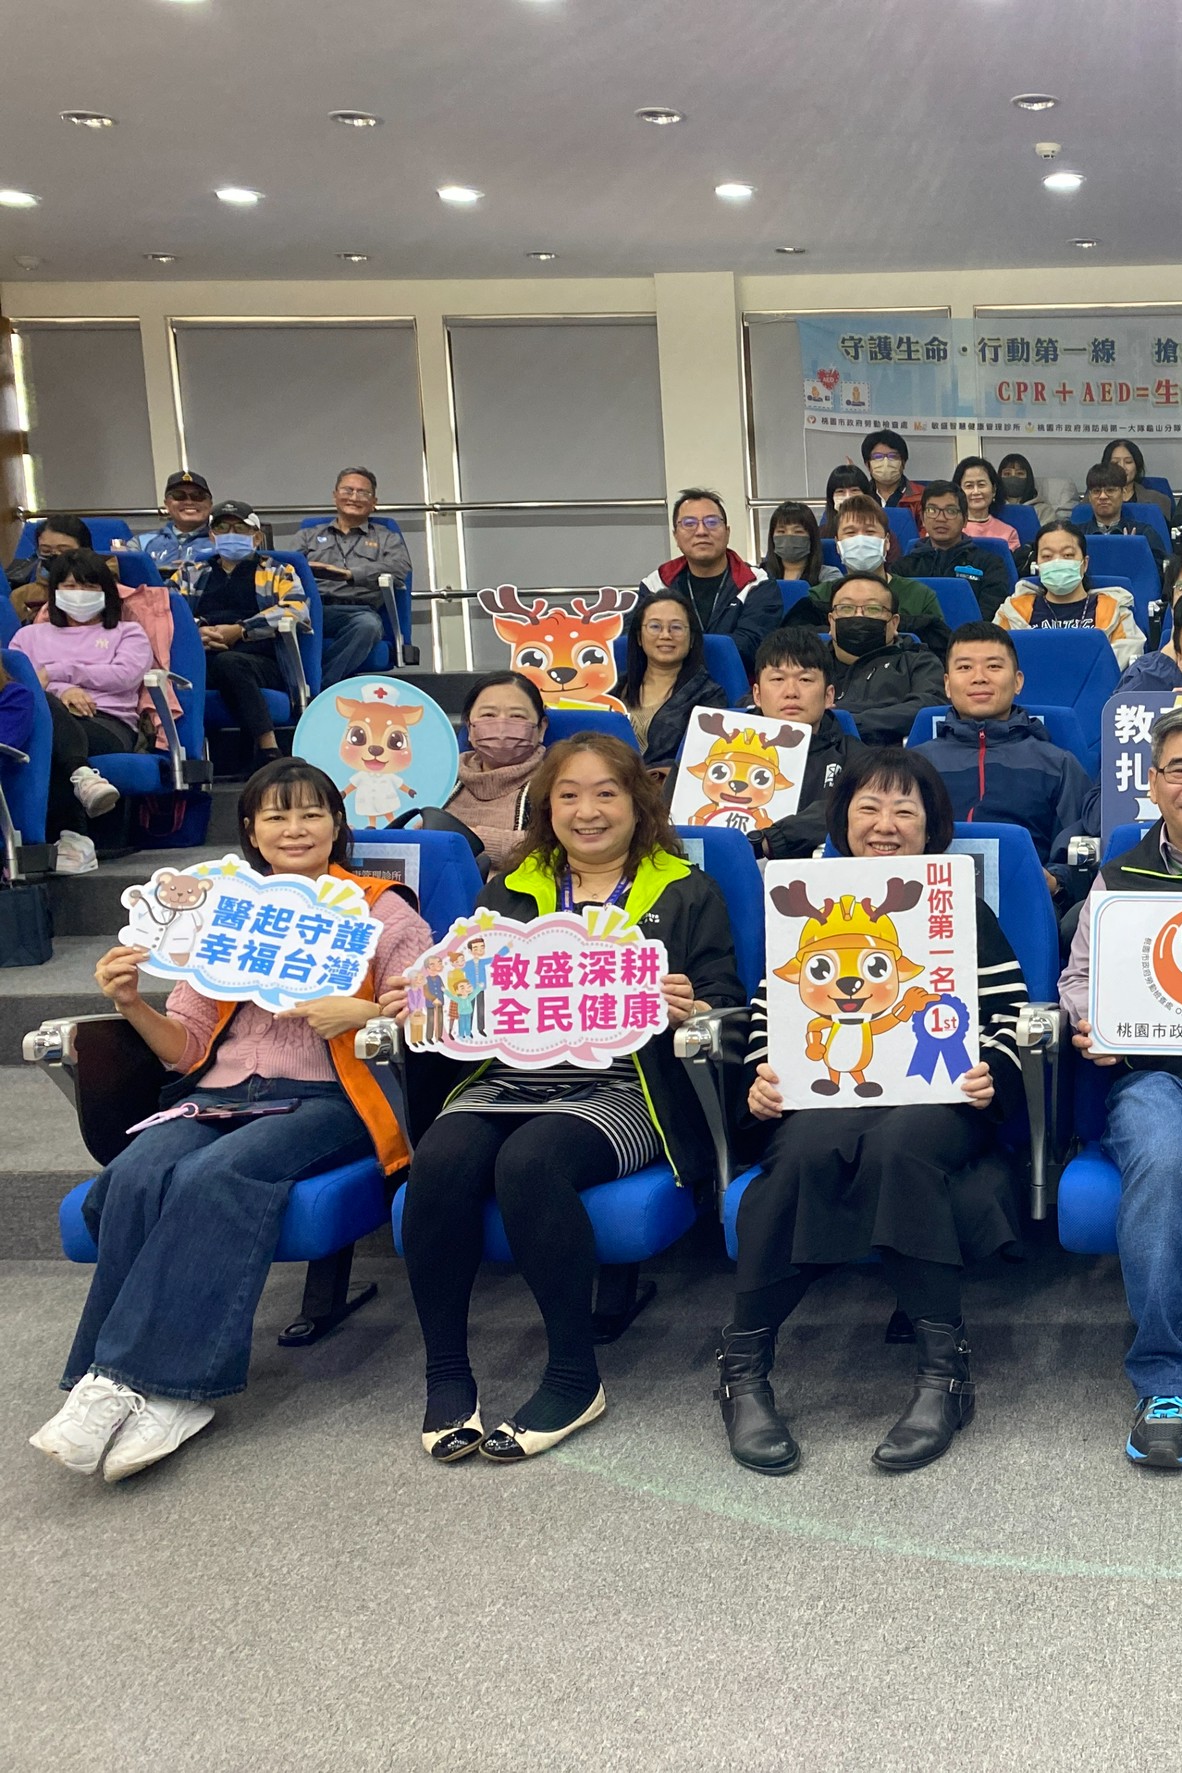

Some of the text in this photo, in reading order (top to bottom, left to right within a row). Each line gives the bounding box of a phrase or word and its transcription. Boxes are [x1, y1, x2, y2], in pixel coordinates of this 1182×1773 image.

[211, 895, 376, 956] 醫起守護
[926, 862, 955, 993] 叫你第一名
[195, 933, 360, 991] 幸福台灣
[490, 946, 660, 991] 敏盛深耕
[491, 991, 661, 1035] 全民健康
[931, 1007, 957, 1033] 1st
